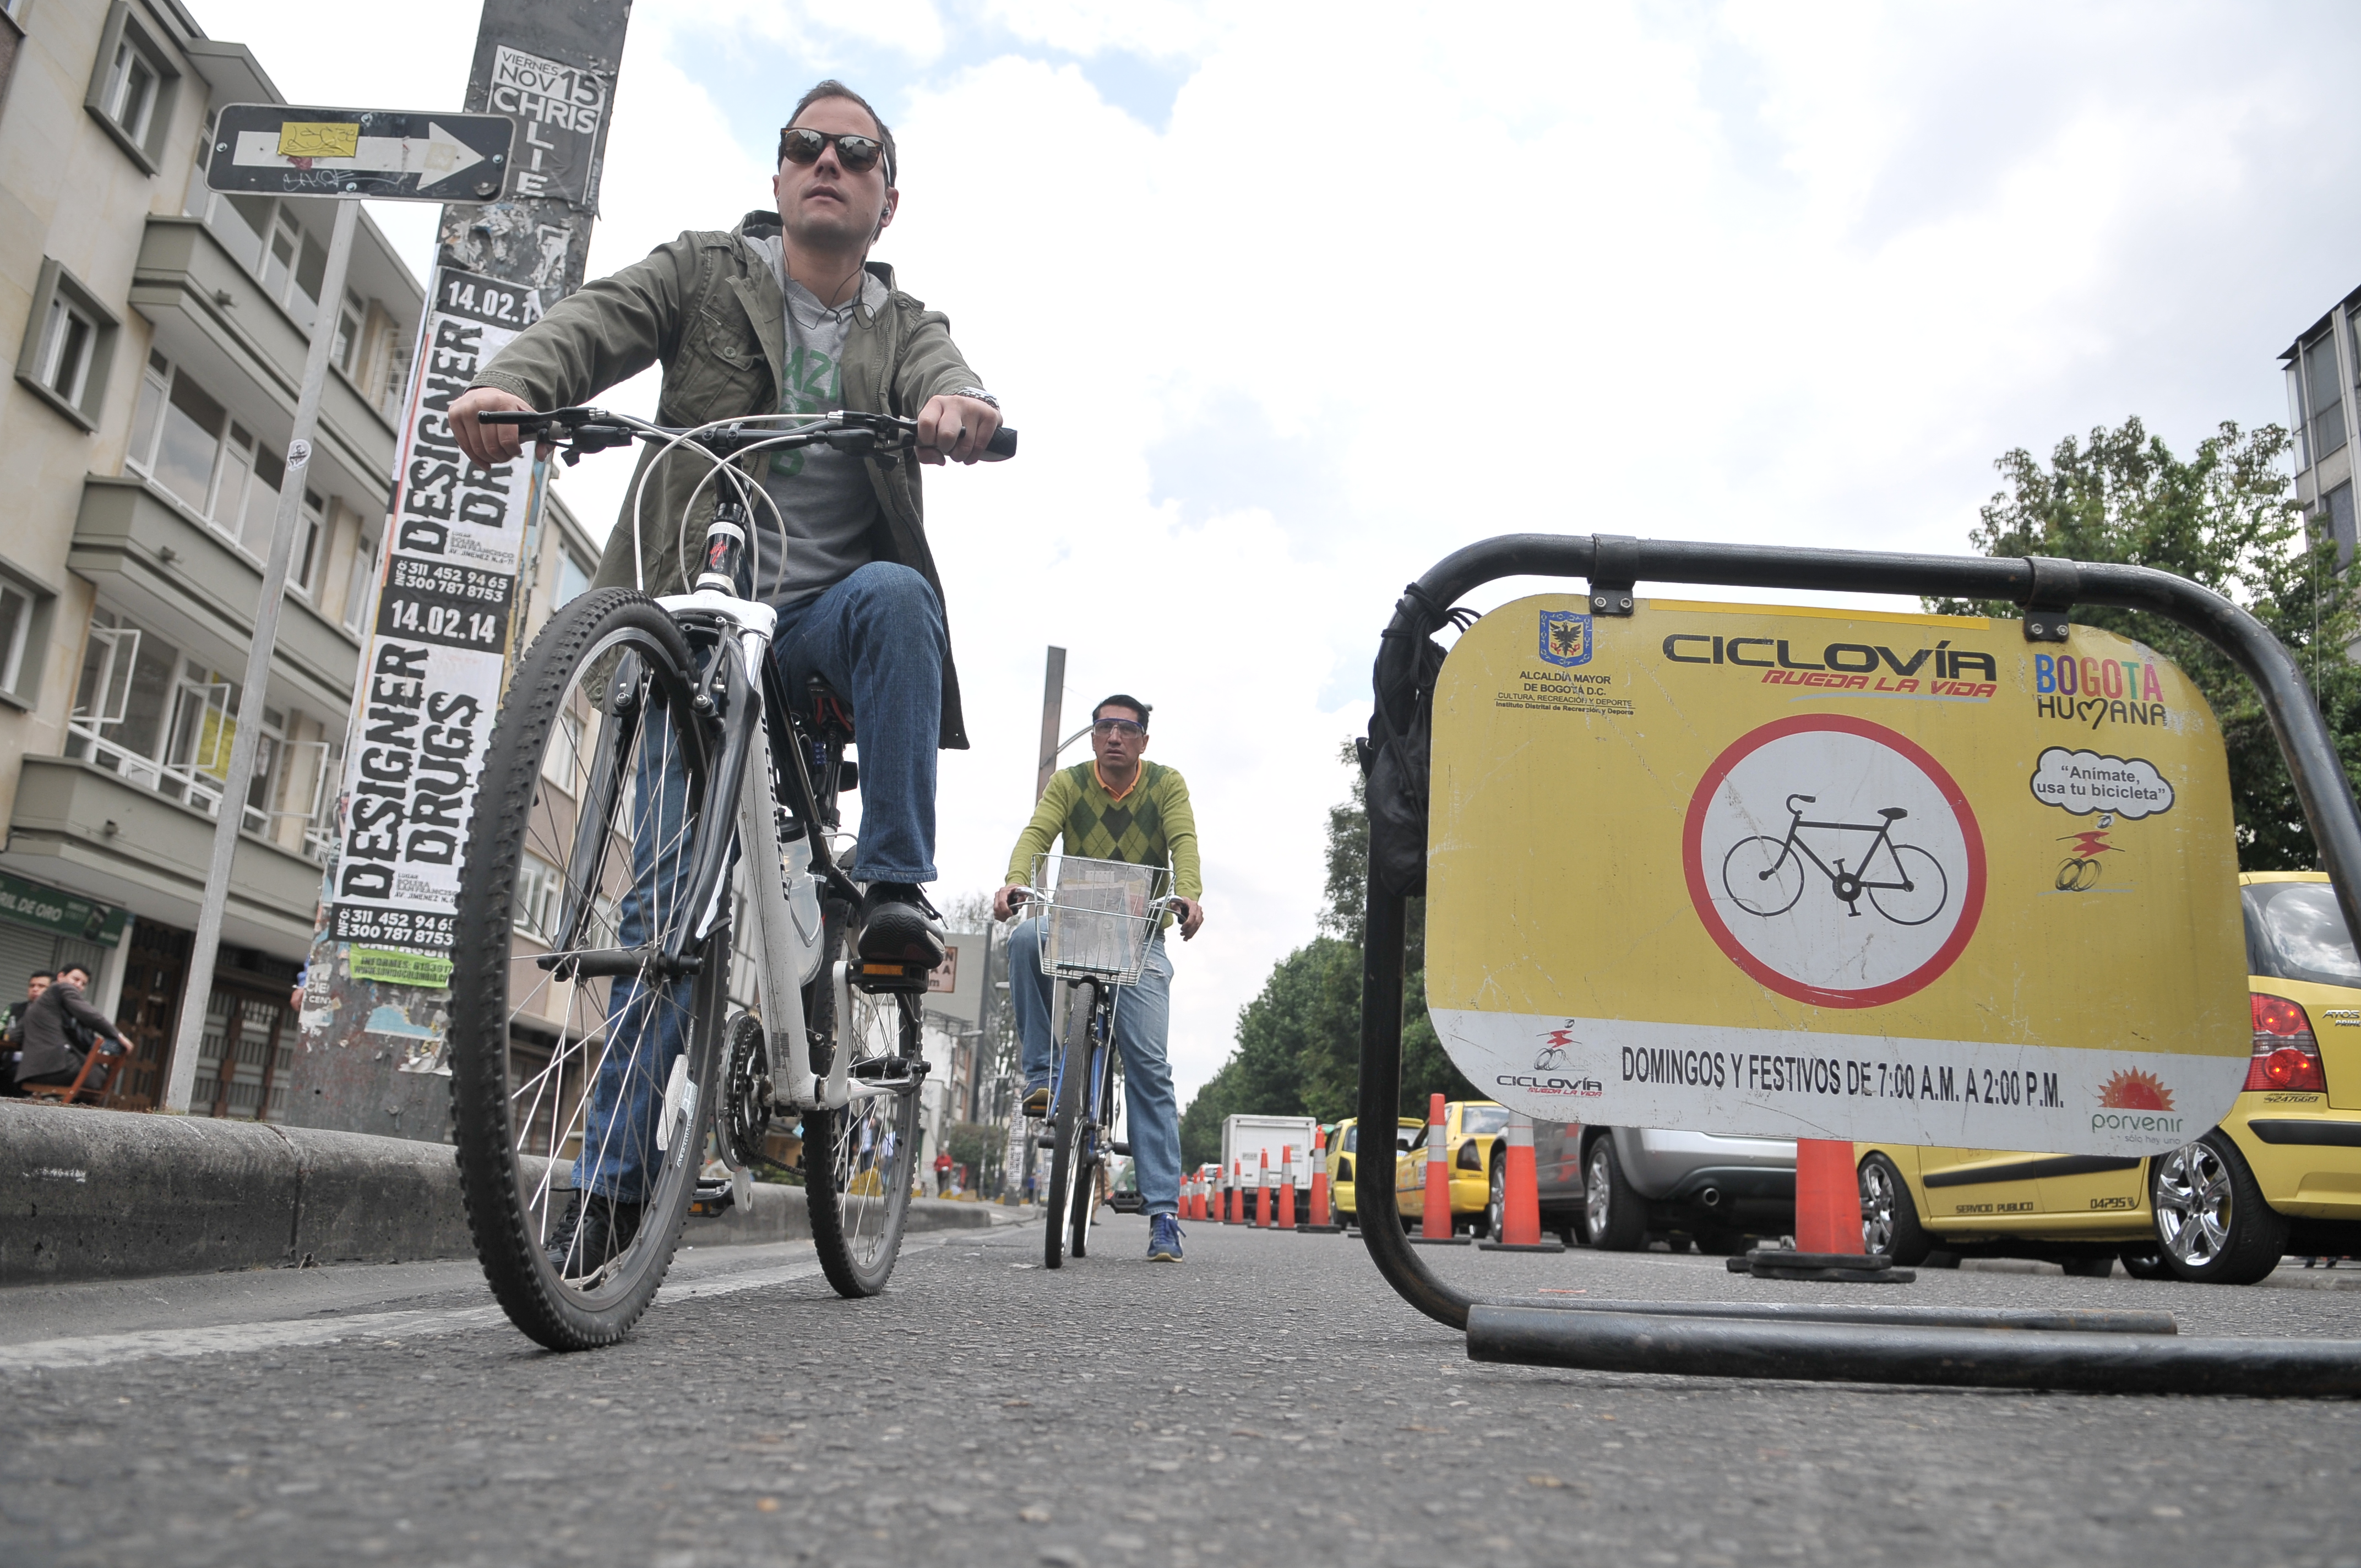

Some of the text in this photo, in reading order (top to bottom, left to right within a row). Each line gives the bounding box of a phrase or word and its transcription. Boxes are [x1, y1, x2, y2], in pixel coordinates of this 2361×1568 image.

[503, 51, 558, 75] VIERNES
[499, 63, 599, 106] NOV 15
[493, 86, 597, 134] CHRIS
[408, 562, 508, 590] 311 452 94 65
[406, 575, 504, 602] 300 787 8753
[391, 600, 496, 643] 14.02.14
[1662, 634, 1996, 681] CICLOVÍA
[1519, 671, 1611, 684] ALCALDÍA MAYOR
[1524, 683, 1606, 695] DE BOGOTÁ D.C.
[1761, 669, 1997, 697] RUEDA LA VIDA
[1498, 693, 1535, 701] CULTURA,
[1537, 694, 1587, 704] RECREACIÓN
[1596, 698, 1632, 706] DEPORTE
[341, 643, 429, 899] DESIGNER
[405, 691, 483, 865] DRUGS
[2037, 783, 2065, 794] usa
[2070, 783, 2086, 795] tu
[351, 910, 373, 923] 311
[378, 912, 409, 927] 452
[415, 915, 435, 929] 94
[349, 924, 454, 946] 300 787 8753
[2322, 1010, 2360, 1019] ATOS
[1497, 1075, 1602, 1091] CICLOVÍA
[1622, 1046, 1725, 1088] DOMINGOS
[1730, 1053, 1743, 1088] Y
[1749, 1054, 1841, 1095] FESTIVOS
[1847, 1060, 1872, 1096] DE
[1878, 1063, 1914, 1099] 7:00
[1921, 1065, 1960, 1102] A.M.
[1965, 1068, 1979, 1103] A
[1984, 1069, 2020, 1105] 2:00
[2092, 1114, 2183, 1133] porvenir
[2145, 1135, 2160, 1145] hay
[1956, 1202, 2033, 1213] SERVICIO PUBLICO
